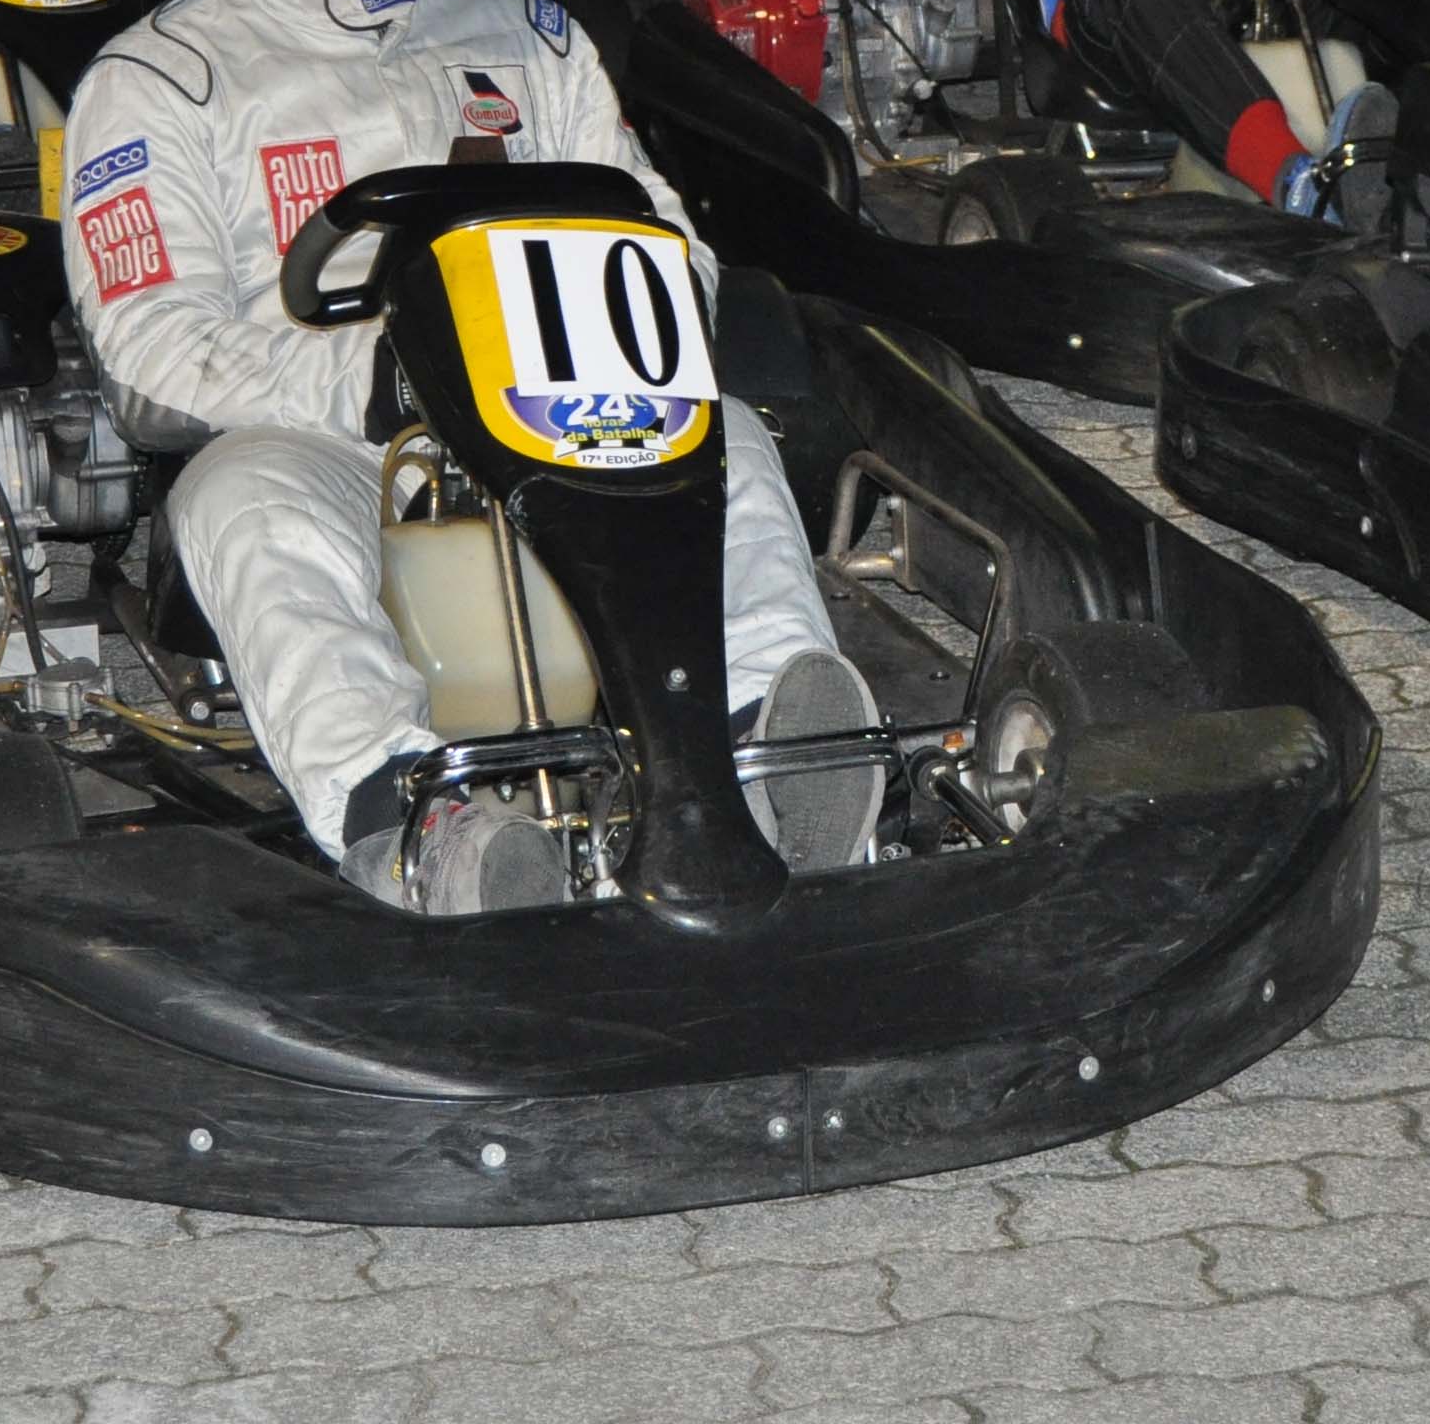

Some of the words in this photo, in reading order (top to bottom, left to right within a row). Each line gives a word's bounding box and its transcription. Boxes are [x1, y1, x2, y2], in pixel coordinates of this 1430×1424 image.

[269, 145, 340, 199] auto
[87, 197, 154, 253] auto
[98, 233, 160, 289] hoje
[522, 239, 680, 387] 10
[562, 394, 635, 426] 24
[566, 431, 588, 443] da
[592, 427, 657, 440] Batalha
[606, 451, 656, 464] EDIÇÃO
